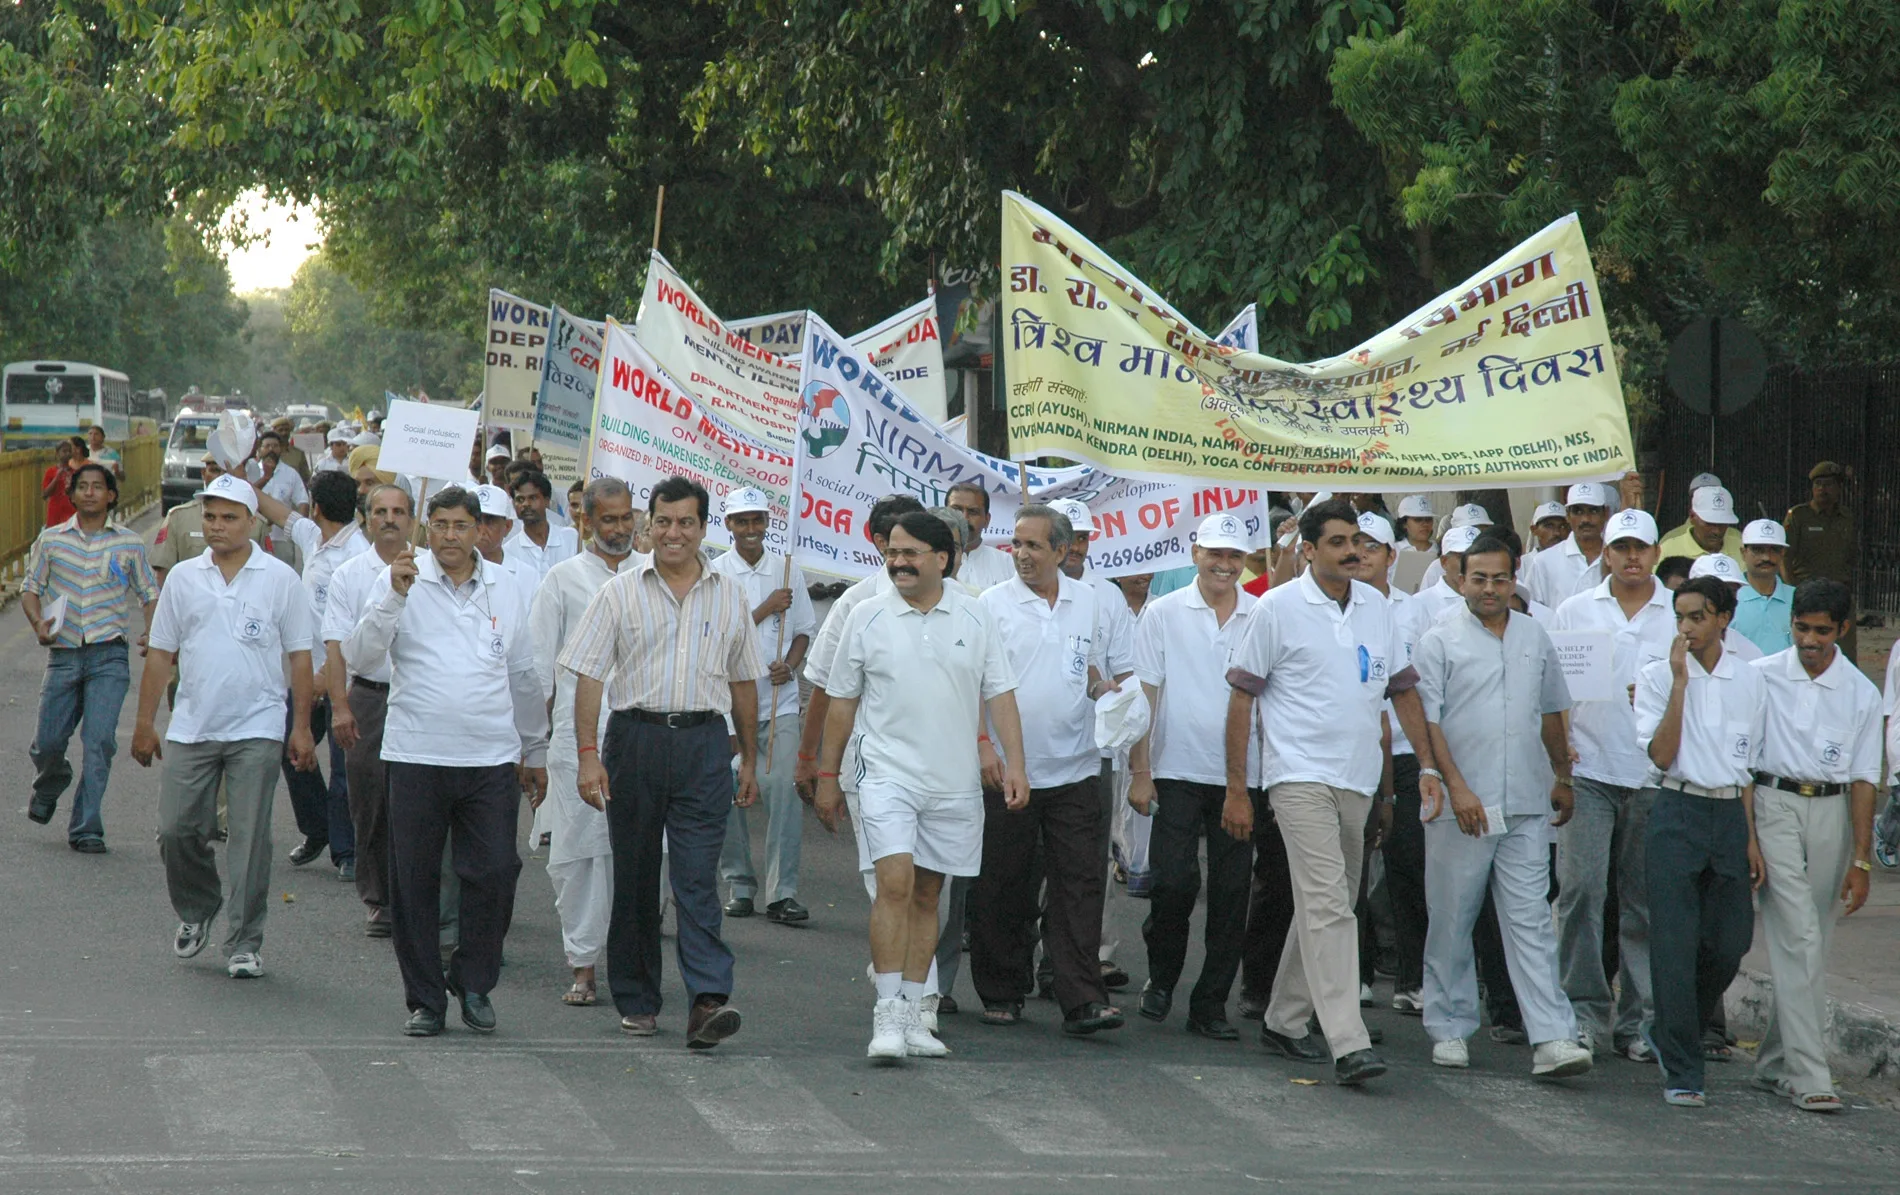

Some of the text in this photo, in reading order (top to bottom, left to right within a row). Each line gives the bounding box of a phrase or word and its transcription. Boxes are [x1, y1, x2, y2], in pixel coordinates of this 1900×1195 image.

[492, 300, 549, 328] WORL
[761, 323, 802, 344] DAY
[657, 278, 720, 336] WORLD
[490, 329, 545, 347] DEP
[684, 334, 745, 379] MENTAL
[884, 366, 928, 382] CIDE
[702, 335, 745, 365] BUILDING
[486, 352, 518, 368] DR.
[1478, 344, 1606, 397] दिवस
[612, 357, 692, 421] WORLD
[690, 371, 779, 417] DEPARTMENT
[762, 391, 797, 410] Organiz
[403, 424, 426, 434] Social
[492, 408, 535, 420] (RESEAR
[601, 414, 650, 444] BUILDING
[420, 438, 455, 448] exclusion
[671, 426, 698, 445] ON
[766, 431, 795, 445] Suppo
[1086, 432, 1137, 456] KENDRA
[1142, 446, 1197, 466] (DELHI),
[1202, 454, 1239, 469] YOGA
[1243, 459, 1359, 475] CONFEDERATION
[1363, 466, 1382, 475] OF
[1384, 466, 1428, 478] INDIA,
[1432, 463, 1481, 476] SPORTS
[1485, 458, 1558, 474] AUTHORITY
[1563, 455, 1580, 467] OF
[1583, 445, 1623, 464] INDIA
[1093, 418, 1149, 438] NIRMAN
[1153, 429, 1198, 448] INDIA,
[1202, 436, 1240, 452] NAMI
[1508, 438, 1563, 458] (DELHI),
[1564, 431, 1595, 448] NSS,
[598, 437, 641, 463] ORGANIZED
[715, 482, 730, 498] OF
[804, 468, 813, 481] A
[816, 475, 855, 497] social
[855, 490, 880, 510] org
[800, 484, 853, 536] OGA
[1138, 497, 1180, 529] OF
